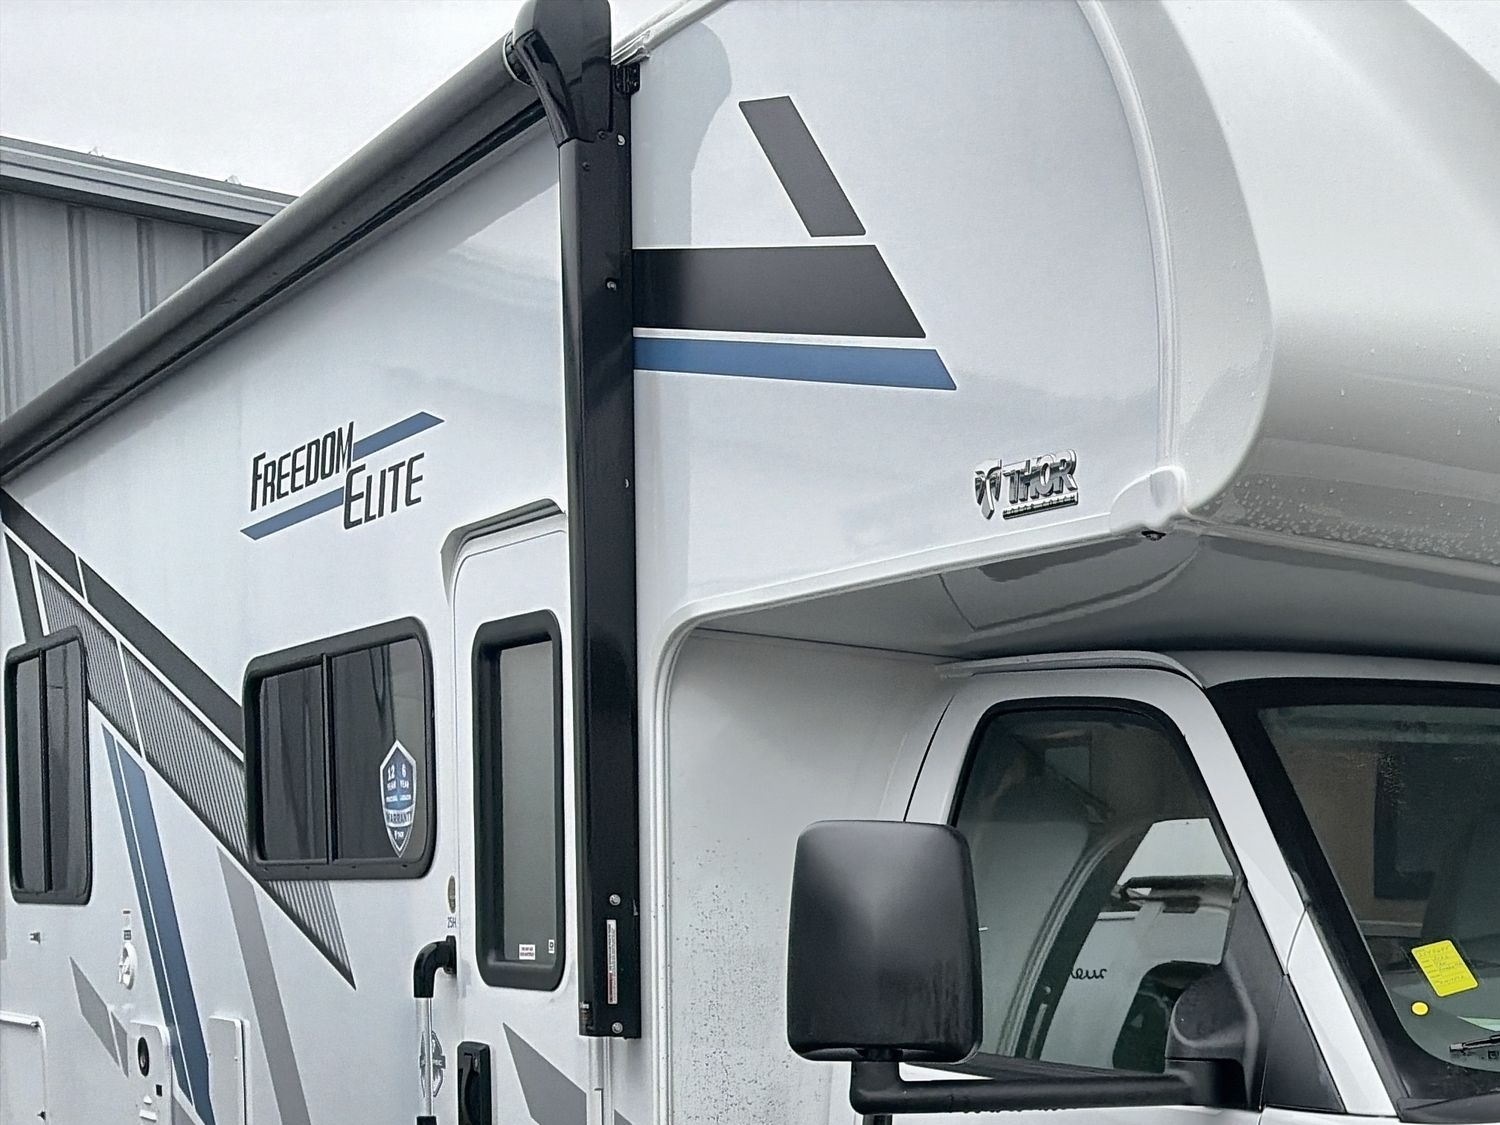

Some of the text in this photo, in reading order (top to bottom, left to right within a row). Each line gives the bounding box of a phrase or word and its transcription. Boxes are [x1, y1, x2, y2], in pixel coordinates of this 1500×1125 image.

[250, 420, 354, 512] FREEDOM
[343, 451, 425, 530] ELITE
[1002, 449, 1078, 505] THOR
[387, 763, 407, 781] 12 6
